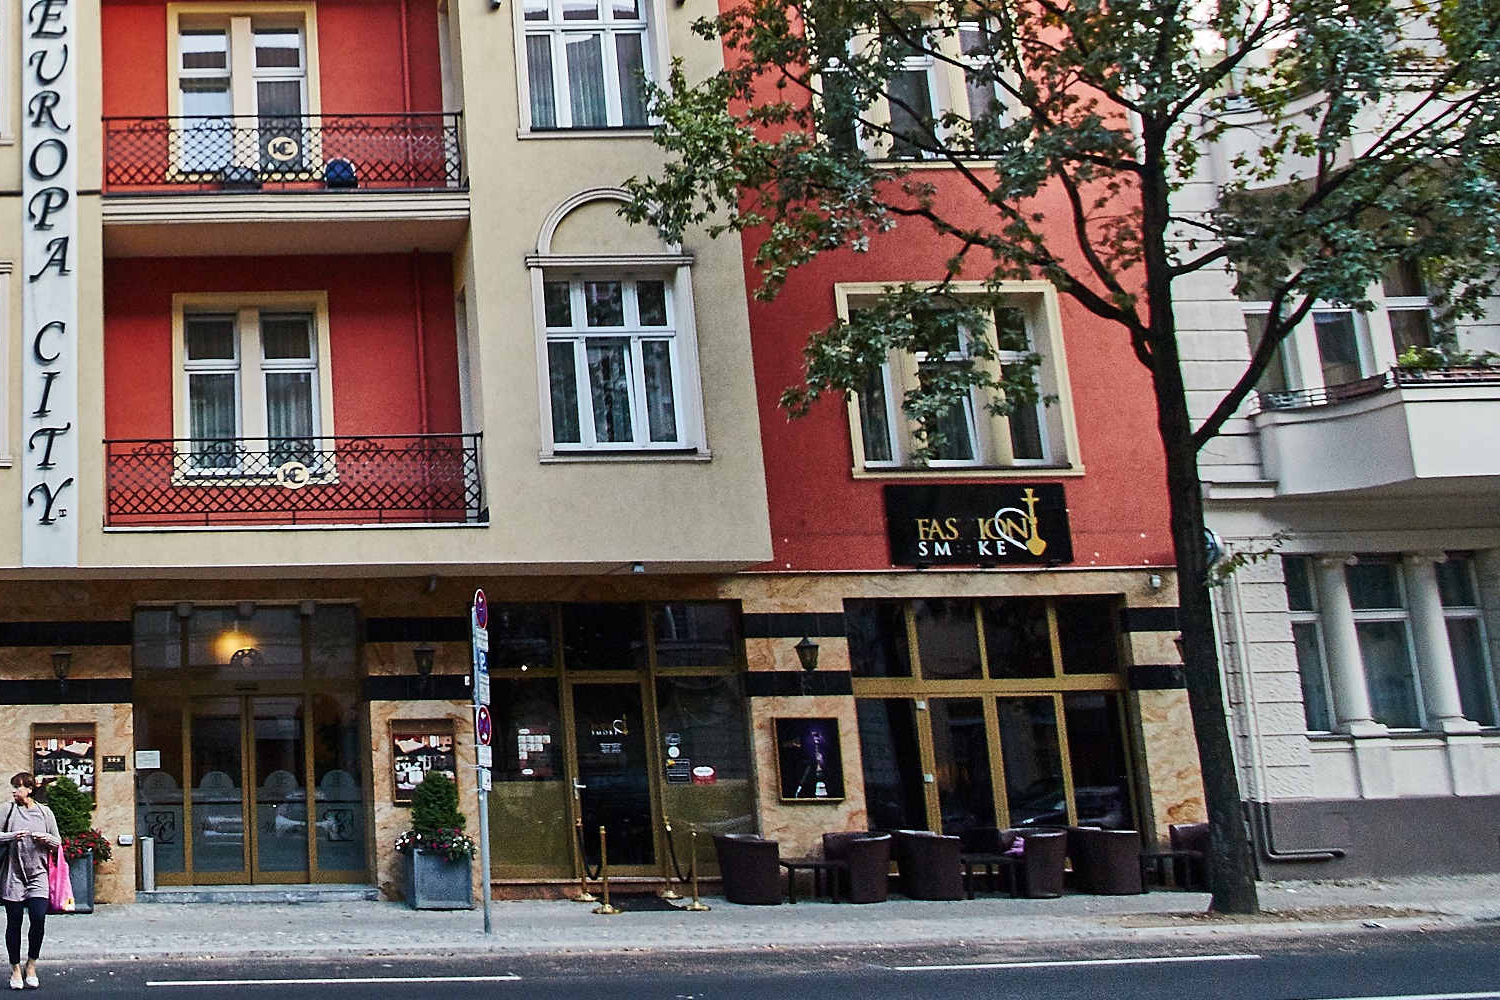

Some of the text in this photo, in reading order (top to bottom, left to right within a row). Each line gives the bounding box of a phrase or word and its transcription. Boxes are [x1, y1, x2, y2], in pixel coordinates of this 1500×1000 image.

[28, 320, 74, 526] CITY
[916, 517, 1029, 541] FASION
[918, 540, 1007, 557] SMKE
